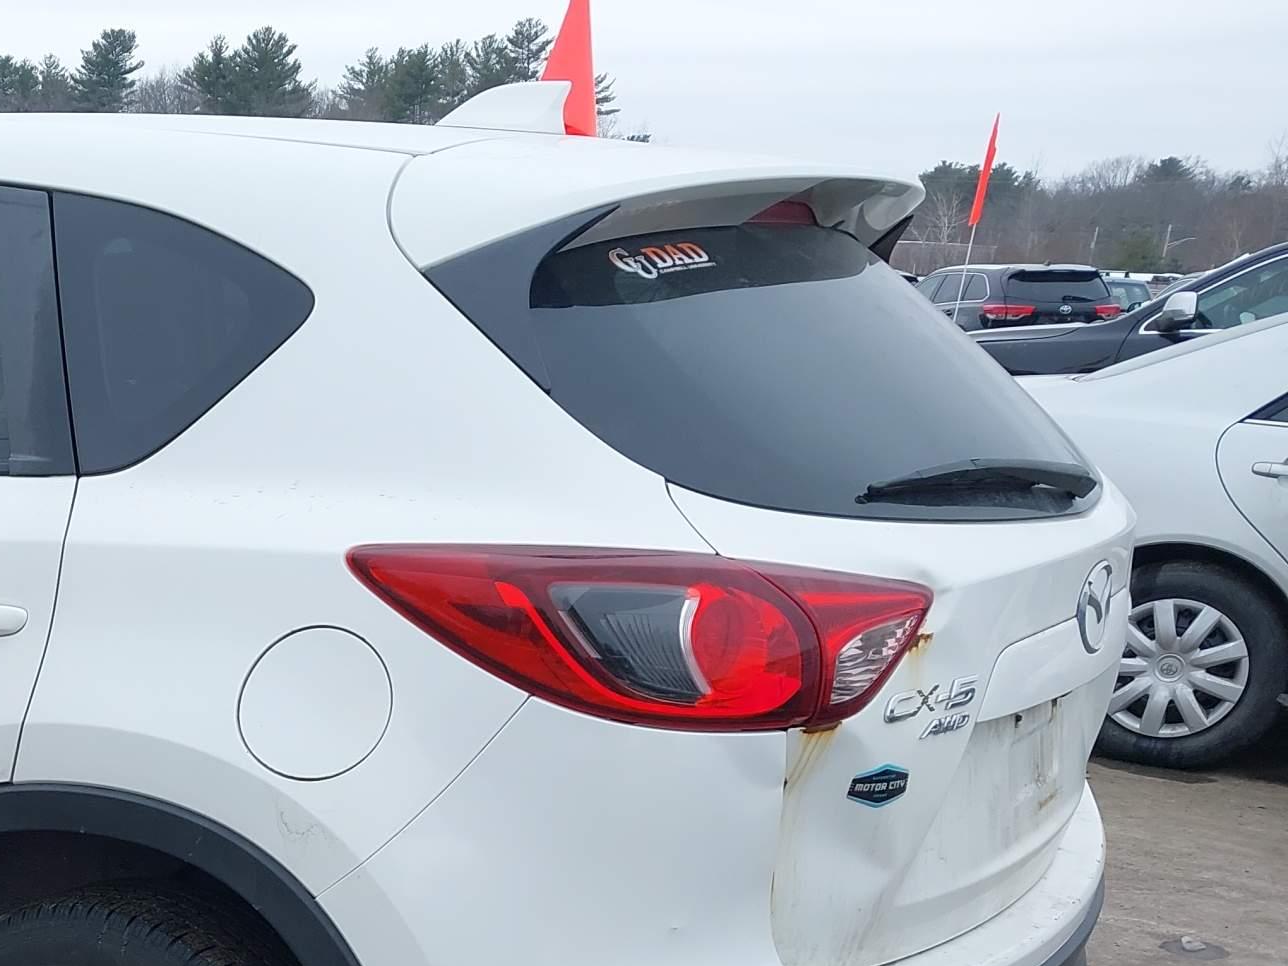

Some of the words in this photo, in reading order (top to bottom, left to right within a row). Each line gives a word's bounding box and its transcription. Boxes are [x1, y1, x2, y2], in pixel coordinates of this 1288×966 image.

[640, 242, 710, 268] DAD
[883, 674, 978, 724] CX-5
[919, 711, 970, 740] AWD
[854, 782, 888, 792] MOTOR
[888, 779, 906, 790] CITY
